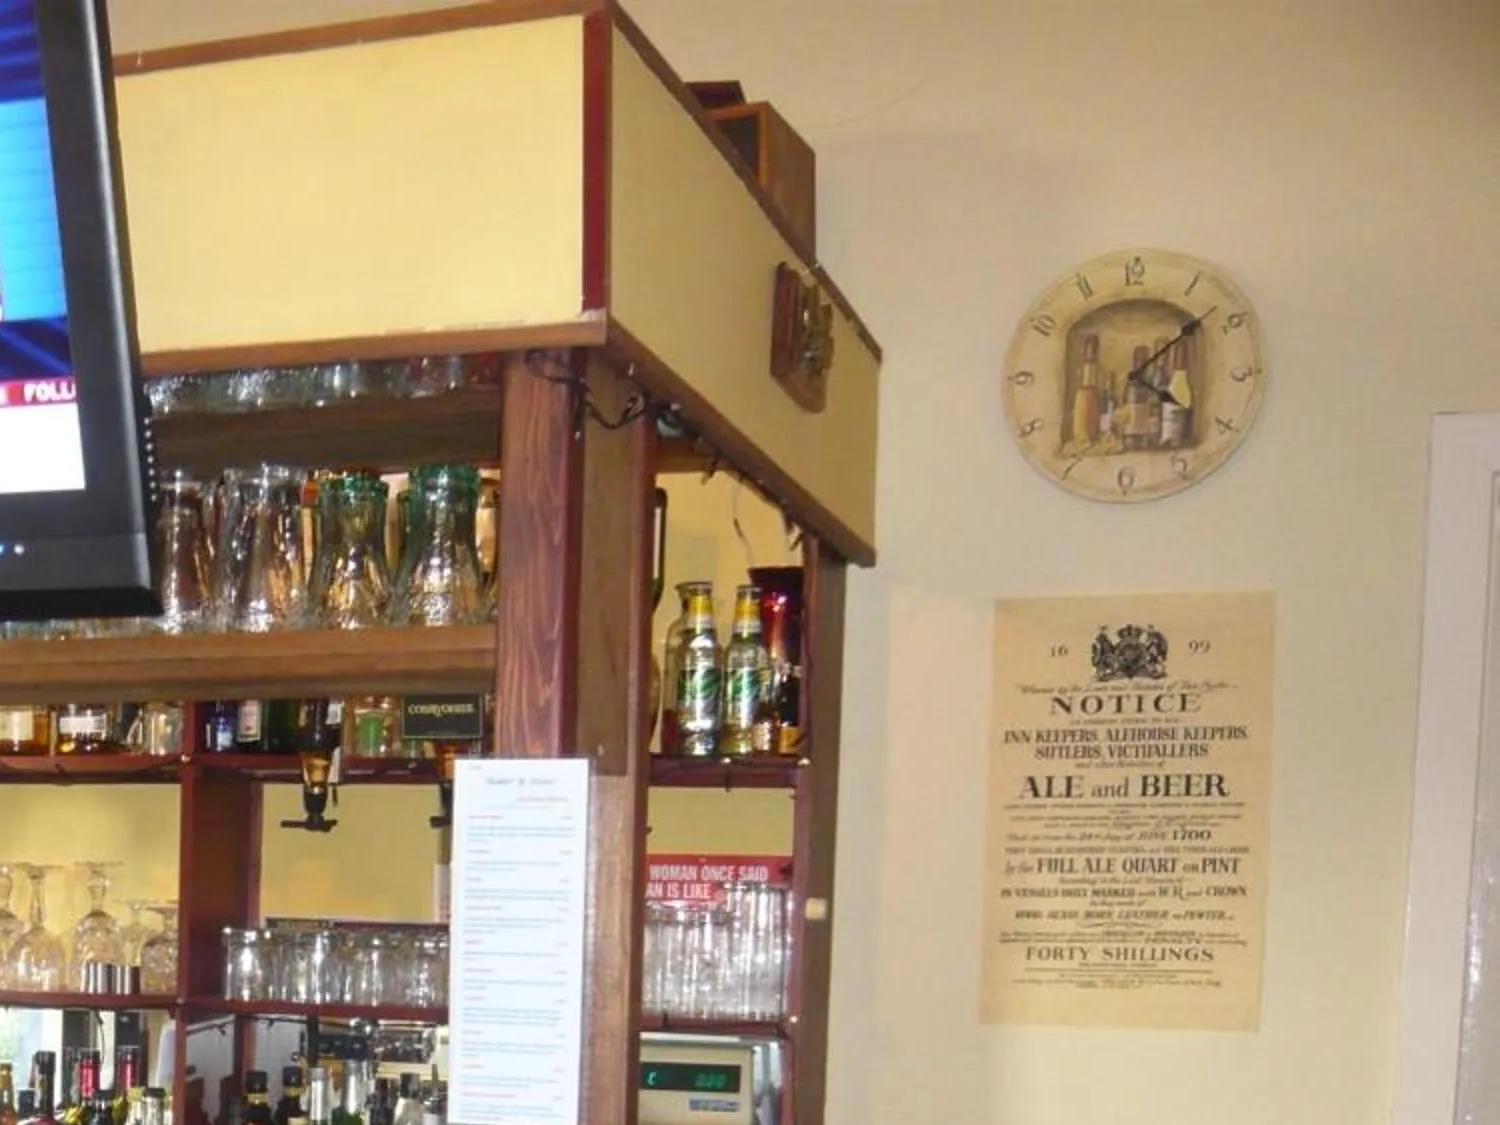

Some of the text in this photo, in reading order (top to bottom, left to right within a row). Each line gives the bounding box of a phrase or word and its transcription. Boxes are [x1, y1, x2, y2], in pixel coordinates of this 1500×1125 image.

[1048, 692, 1203, 717] NOTICE
[1018, 772, 1232, 800] ALE and BEER
[649, 863, 769, 881] WOMAN ONCE SAID
[1036, 857, 1080, 874] FULL
[1083, 857, 1118, 874] ALE
[1200, 856, 1242, 874] PINT
[644, 881, 712, 899] AN IS LIKE
[1024, 946, 1215, 962] FORTY SHILLINGS
